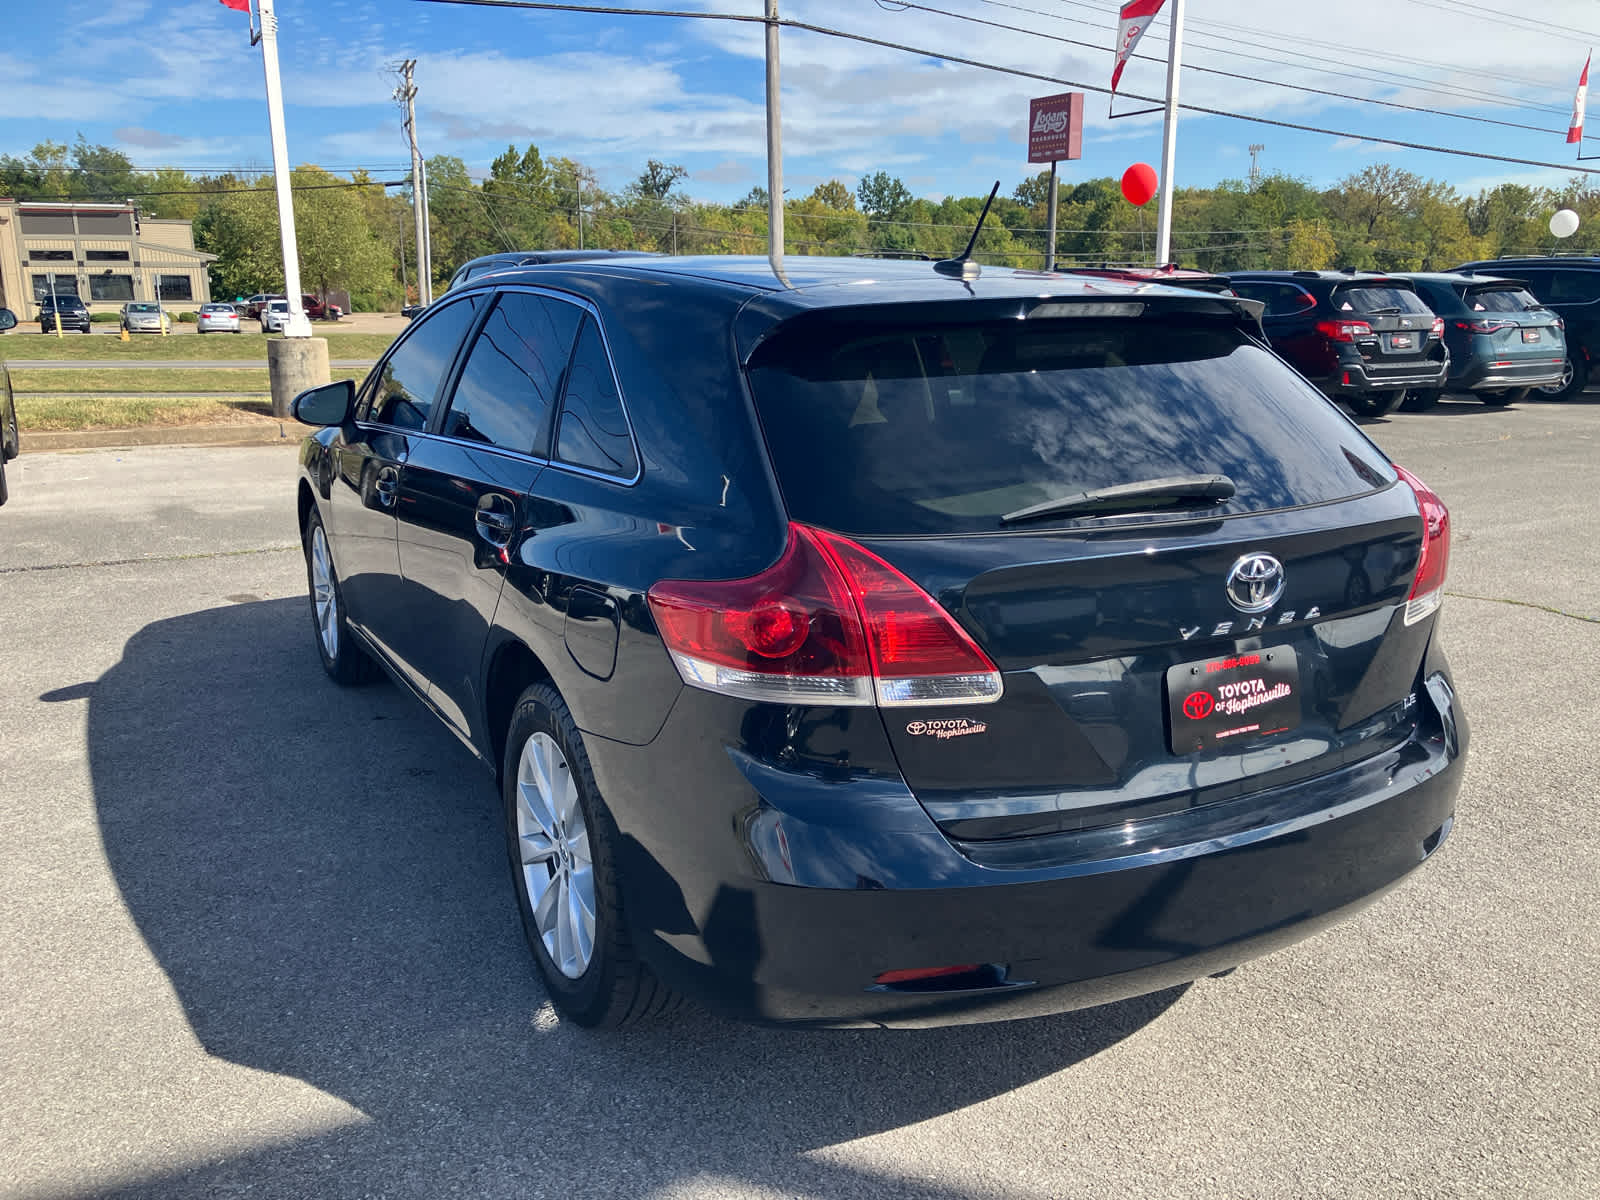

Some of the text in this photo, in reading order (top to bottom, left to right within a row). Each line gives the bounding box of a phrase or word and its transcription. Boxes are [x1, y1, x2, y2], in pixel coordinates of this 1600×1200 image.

[1179, 606, 1321, 640] VENZA
[1215, 683, 1291, 715] OF Hopkinsville
[1218, 679, 1265, 699] TOYOTA
[926, 720, 968, 729] TOYOTA
